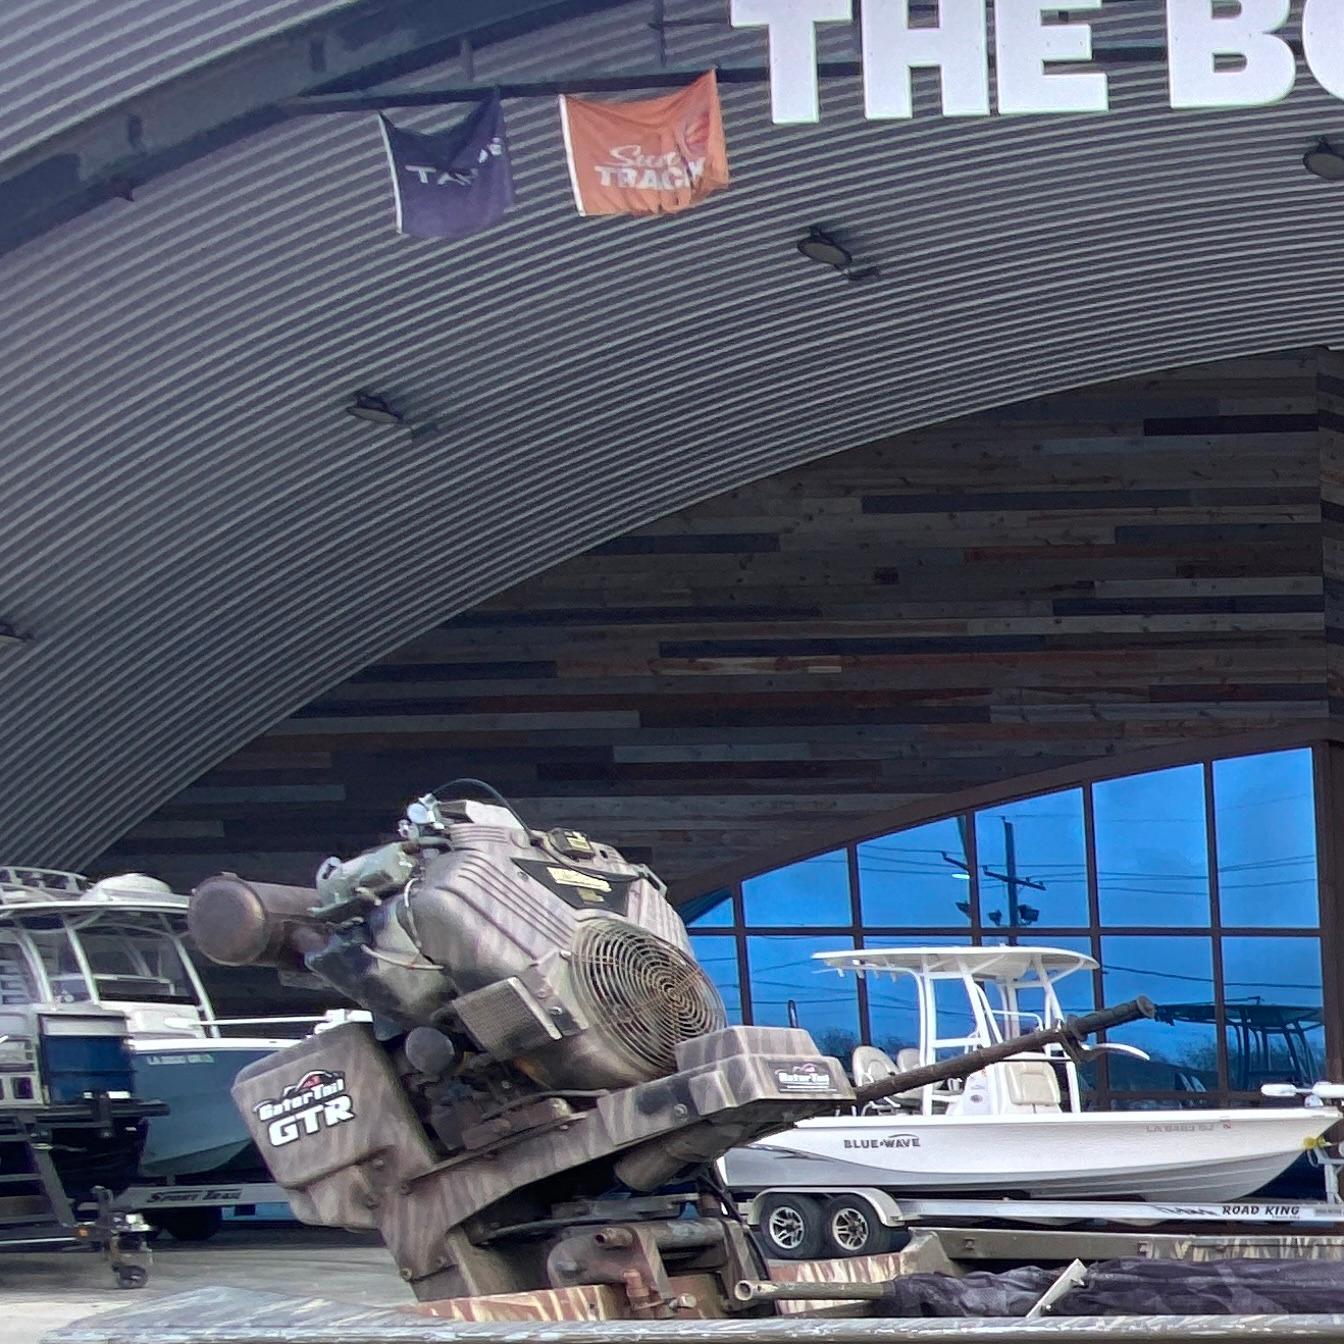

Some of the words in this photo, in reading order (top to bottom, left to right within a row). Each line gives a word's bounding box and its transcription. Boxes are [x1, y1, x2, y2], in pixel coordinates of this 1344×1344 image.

[730, 0, 1110, 124] THE
[268, 1095, 355, 1147] GTR
[843, 1139, 879, 1149] BLUE
[1222, 1205, 1260, 1215] ROAD
[1265, 1205, 1300, 1216] KING
